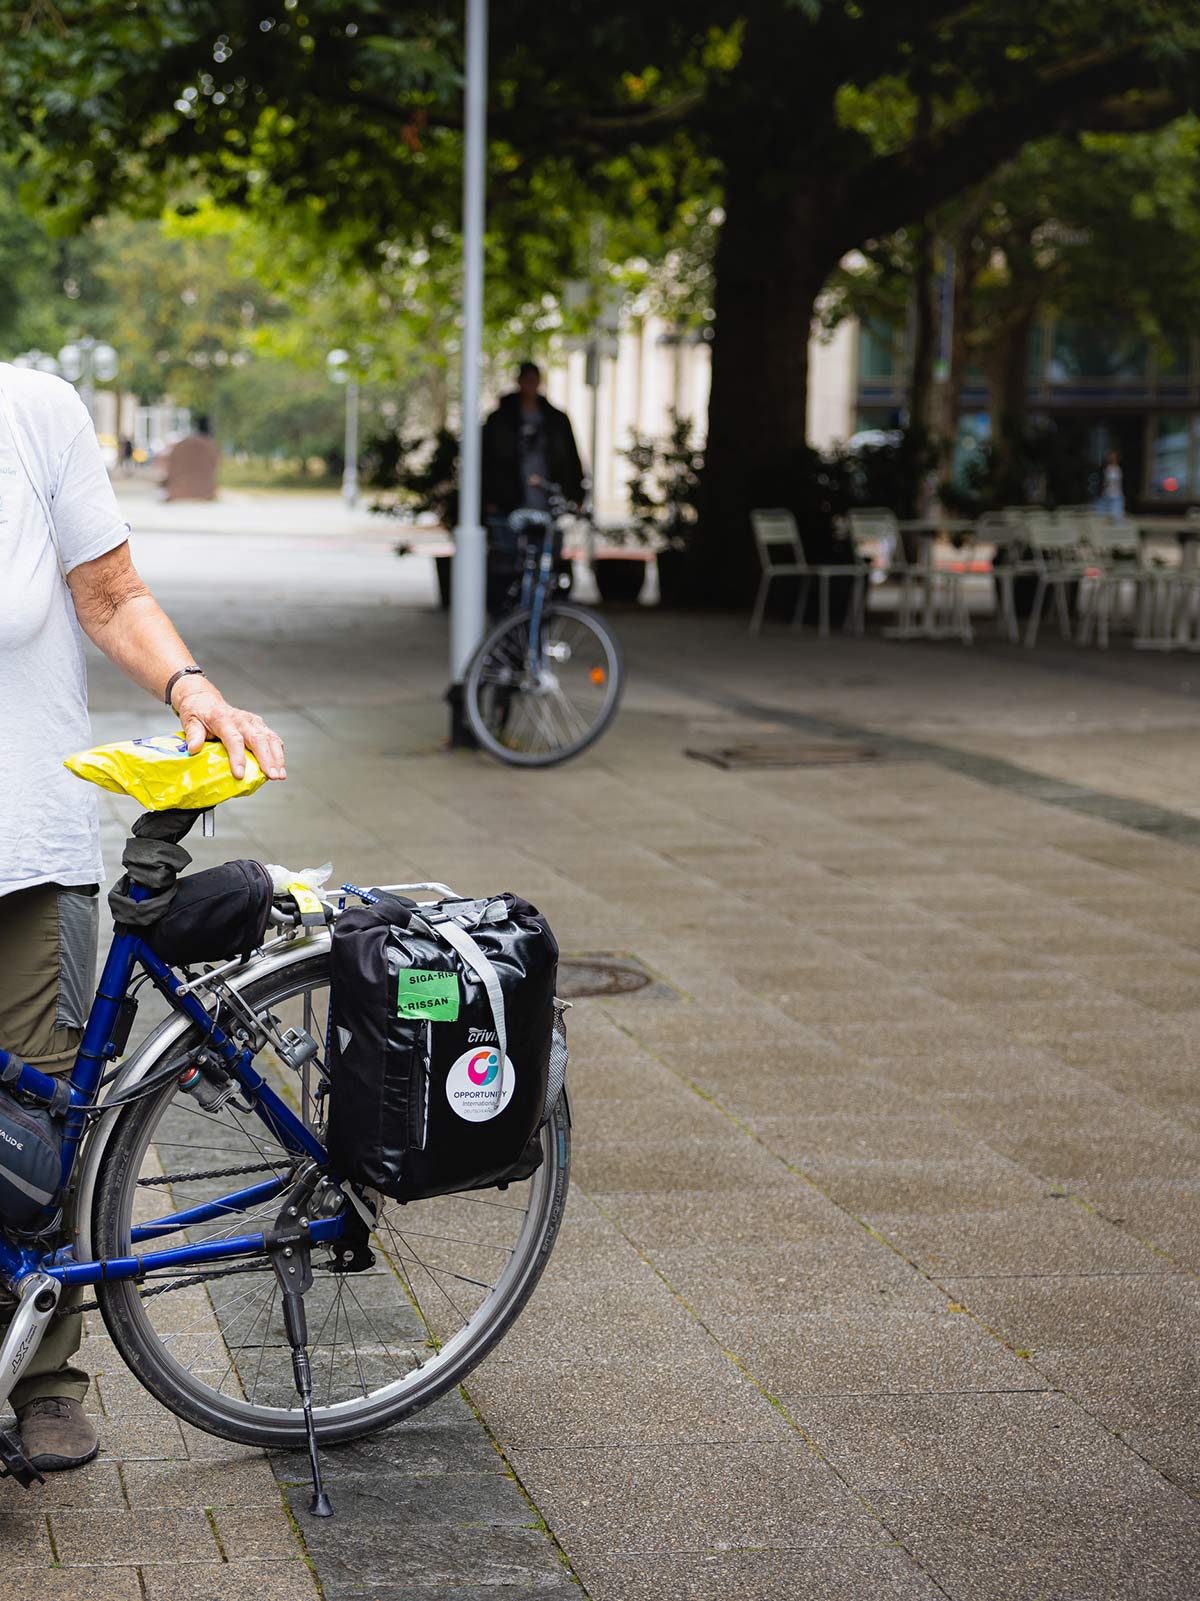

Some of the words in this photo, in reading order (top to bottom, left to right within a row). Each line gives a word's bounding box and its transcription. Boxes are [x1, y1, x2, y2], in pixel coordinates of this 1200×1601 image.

[409, 972, 456, 985] SIGA-RIS
[468, 1028, 498, 1043] crivi
[453, 1090, 507, 1099] OPPORTUNIY
[552, 1169, 565, 1222] MARATHON
[542, 1226, 555, 1252] PLUS
[11, 1341, 29, 1375] XT
